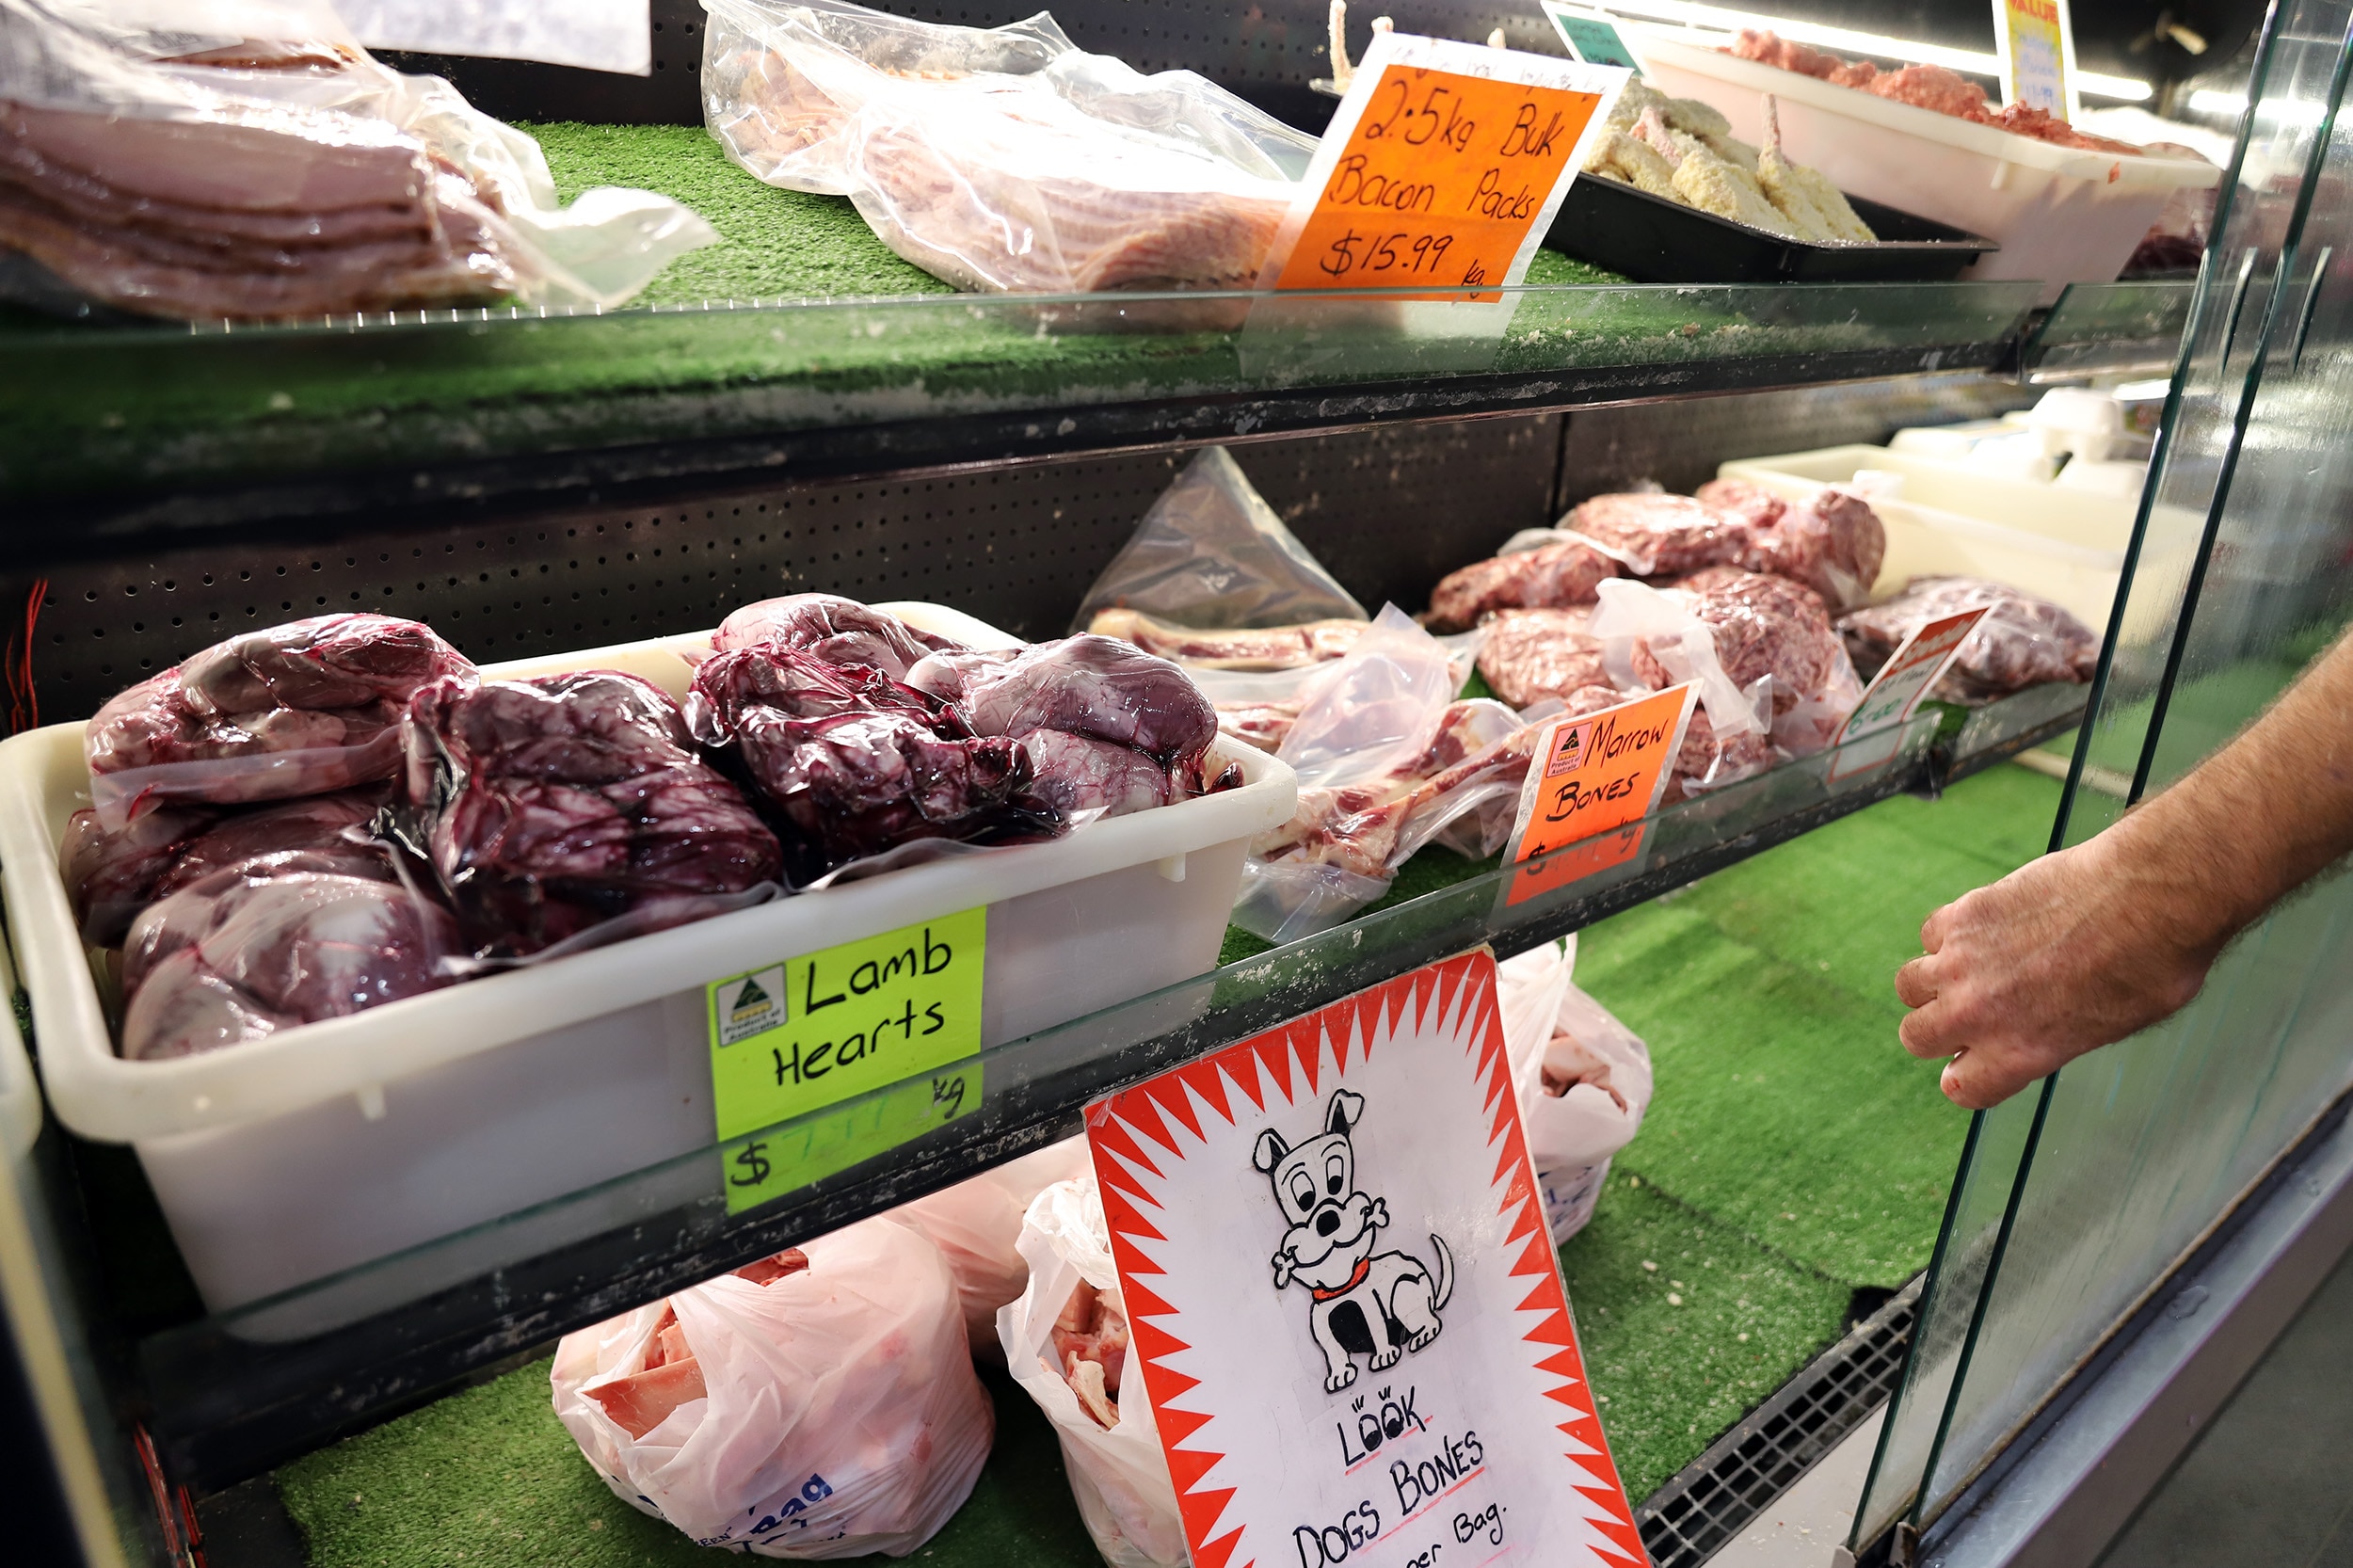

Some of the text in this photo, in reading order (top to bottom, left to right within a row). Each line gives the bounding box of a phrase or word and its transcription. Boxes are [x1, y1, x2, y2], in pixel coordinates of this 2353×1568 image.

[1328, 153, 1535, 219] Bacon Packs
[1320, 229, 1453, 277] $15.99
[1551, 759, 1573, 769] Product
[1583, 715, 1669, 769] Marrow
[806, 927, 952, 1016] Lamb
[773, 999, 945, 1086] Hearts
[730, 1077, 966, 1187] $ kg
[1292, 1431, 1483, 1568] DOGS BONES
